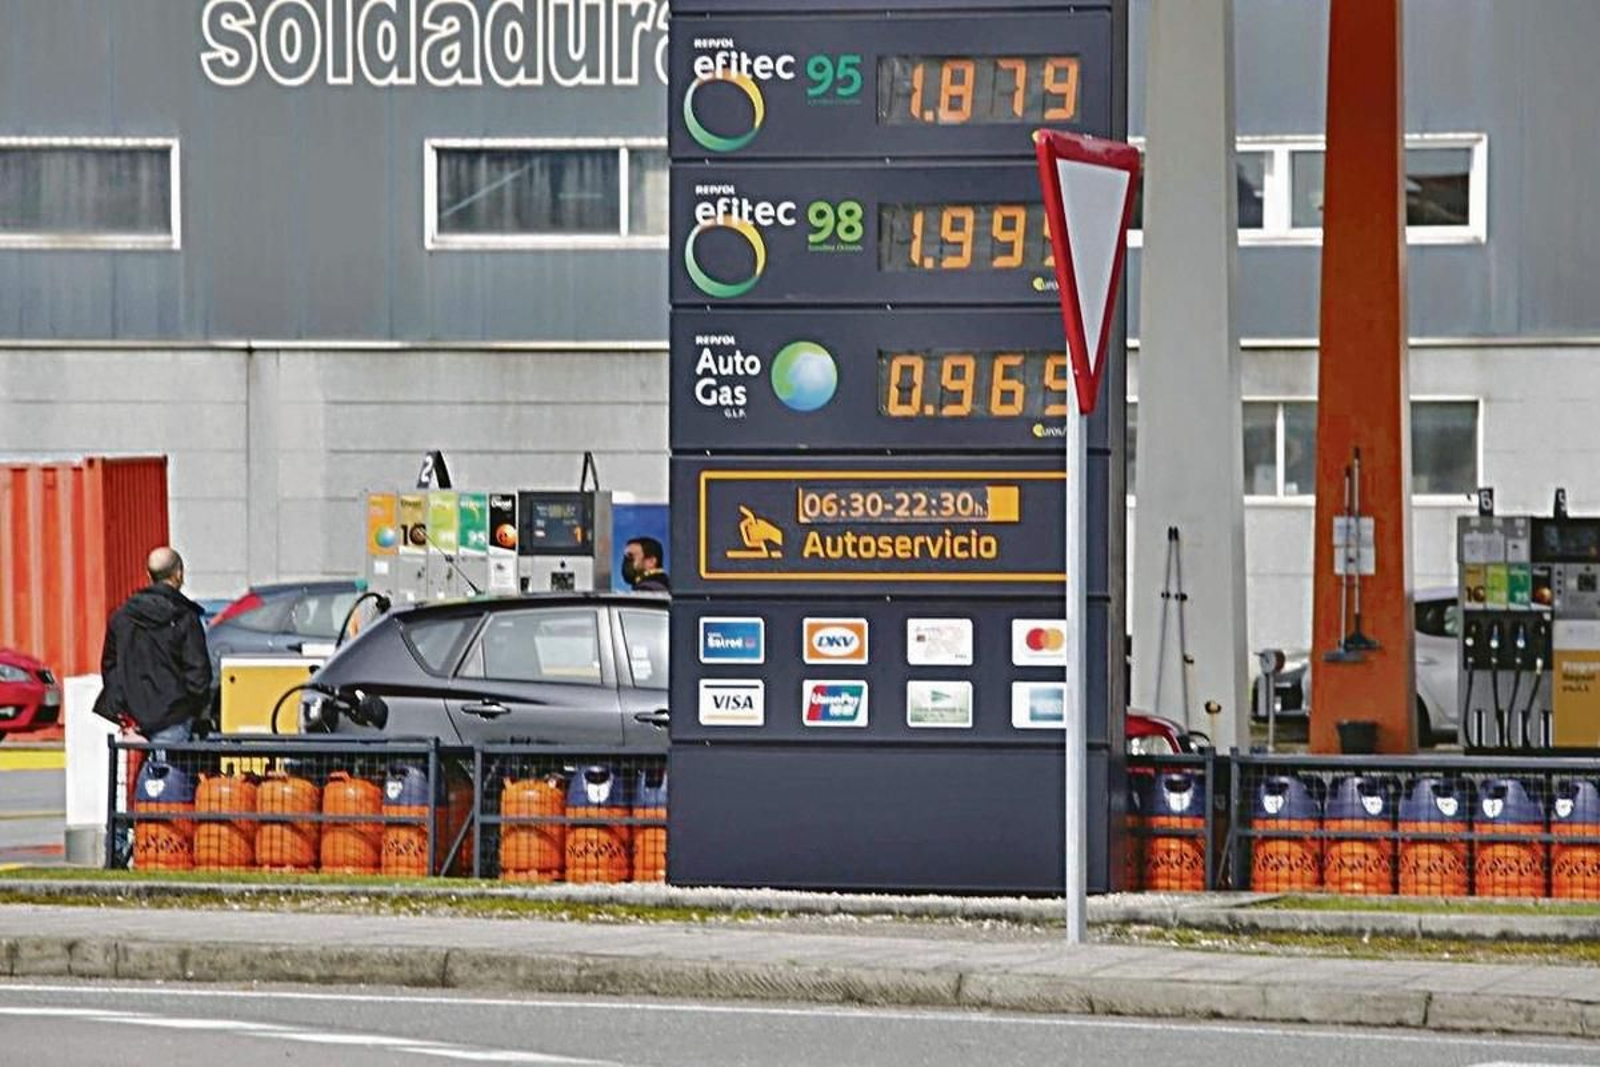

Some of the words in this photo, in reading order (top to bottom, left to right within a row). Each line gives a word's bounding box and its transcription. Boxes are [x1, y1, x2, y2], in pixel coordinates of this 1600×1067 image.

[201, 0, 668, 86] soldadur
[694, 51, 796, 81] efitec
[806, 55, 863, 96] 95
[910, 58, 1079, 122] 1.879
[695, 198, 797, 227] efitec
[808, 201, 864, 243] 98
[911, 205, 1056, 270] 1.99
[695, 347, 761, 376] Auto
[695, 377, 747, 406] Gas
[421, 455, 433, 482] 2
[803, 530, 998, 559] Autoservicio
[818, 635, 854, 648] DKV
[712, 695, 754, 710] VISA
